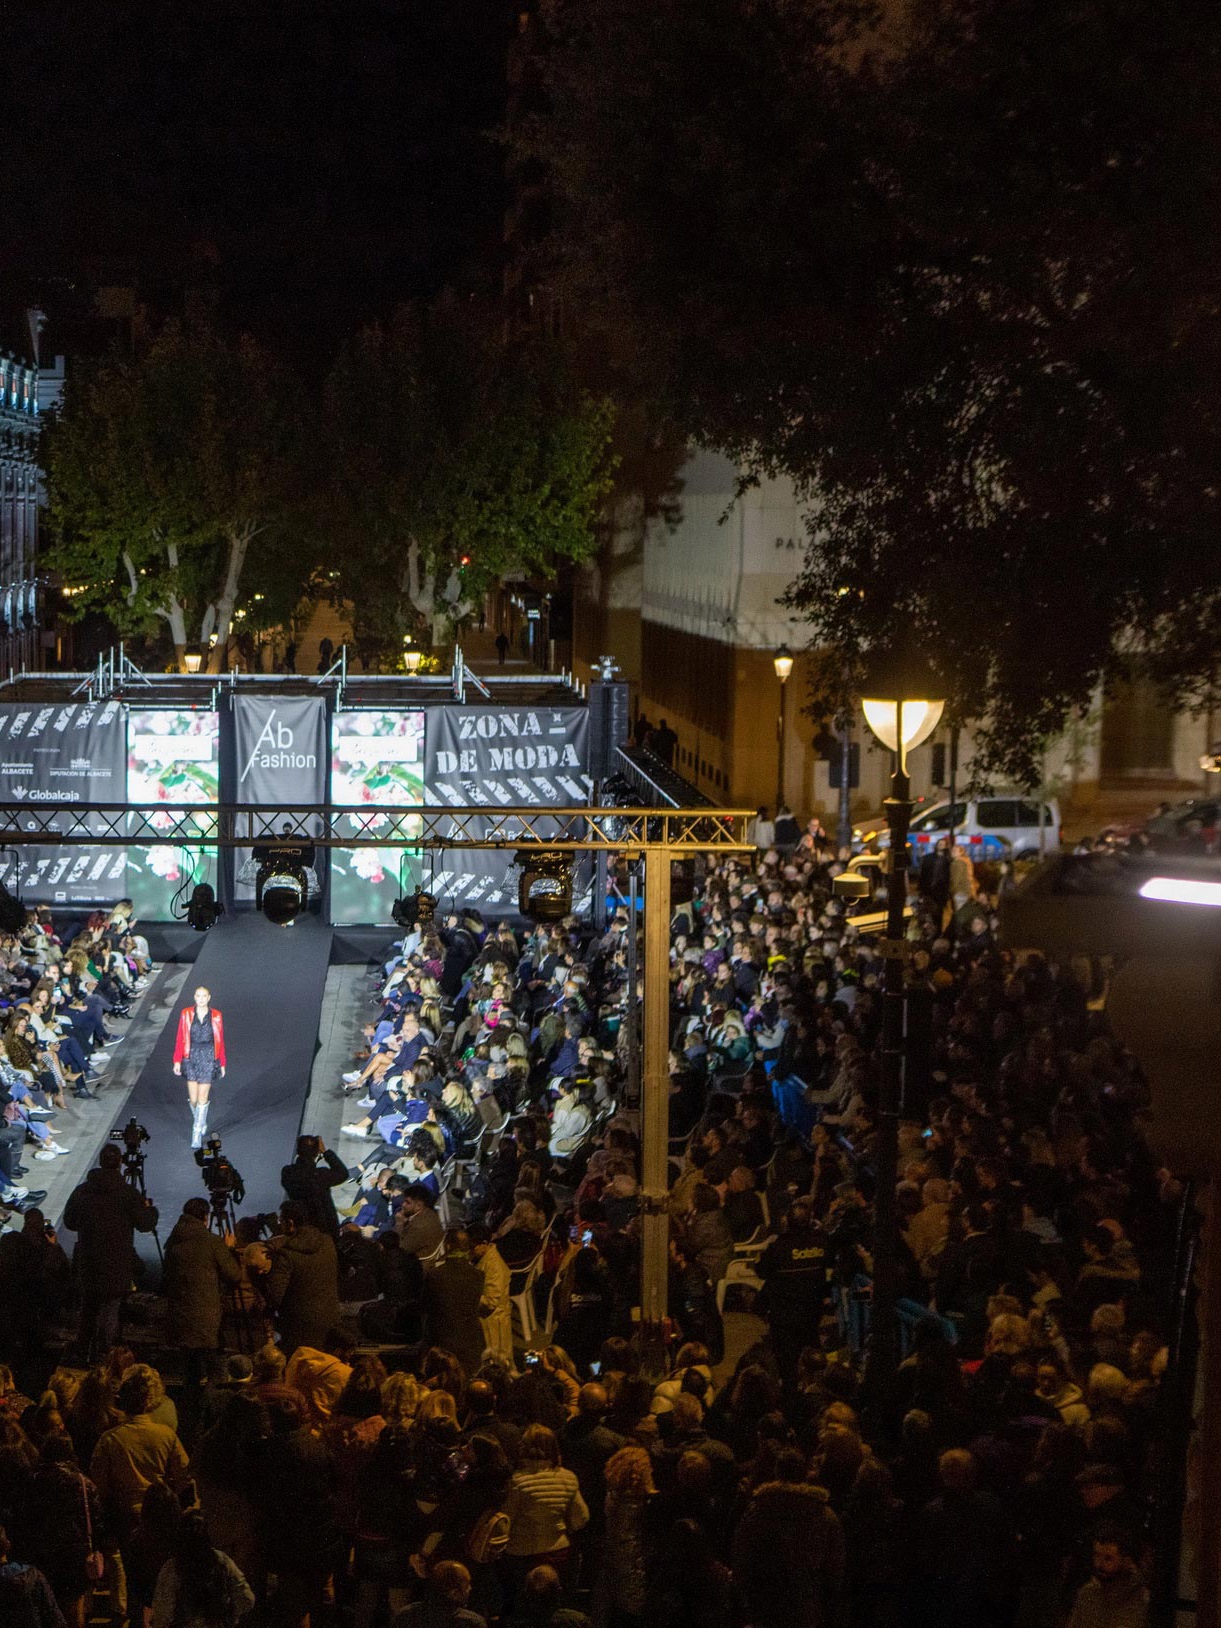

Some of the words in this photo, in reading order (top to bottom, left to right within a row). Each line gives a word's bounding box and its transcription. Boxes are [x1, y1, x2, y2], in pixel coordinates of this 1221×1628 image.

[256, 710, 294, 749] Ab
[458, 712, 542, 739] ZONA
[249, 751, 317, 768] Fashion
[436, 750, 478, 774] DE
[488, 743, 580, 771] MODA
[28, 789, 80, 801] Globalcaja
